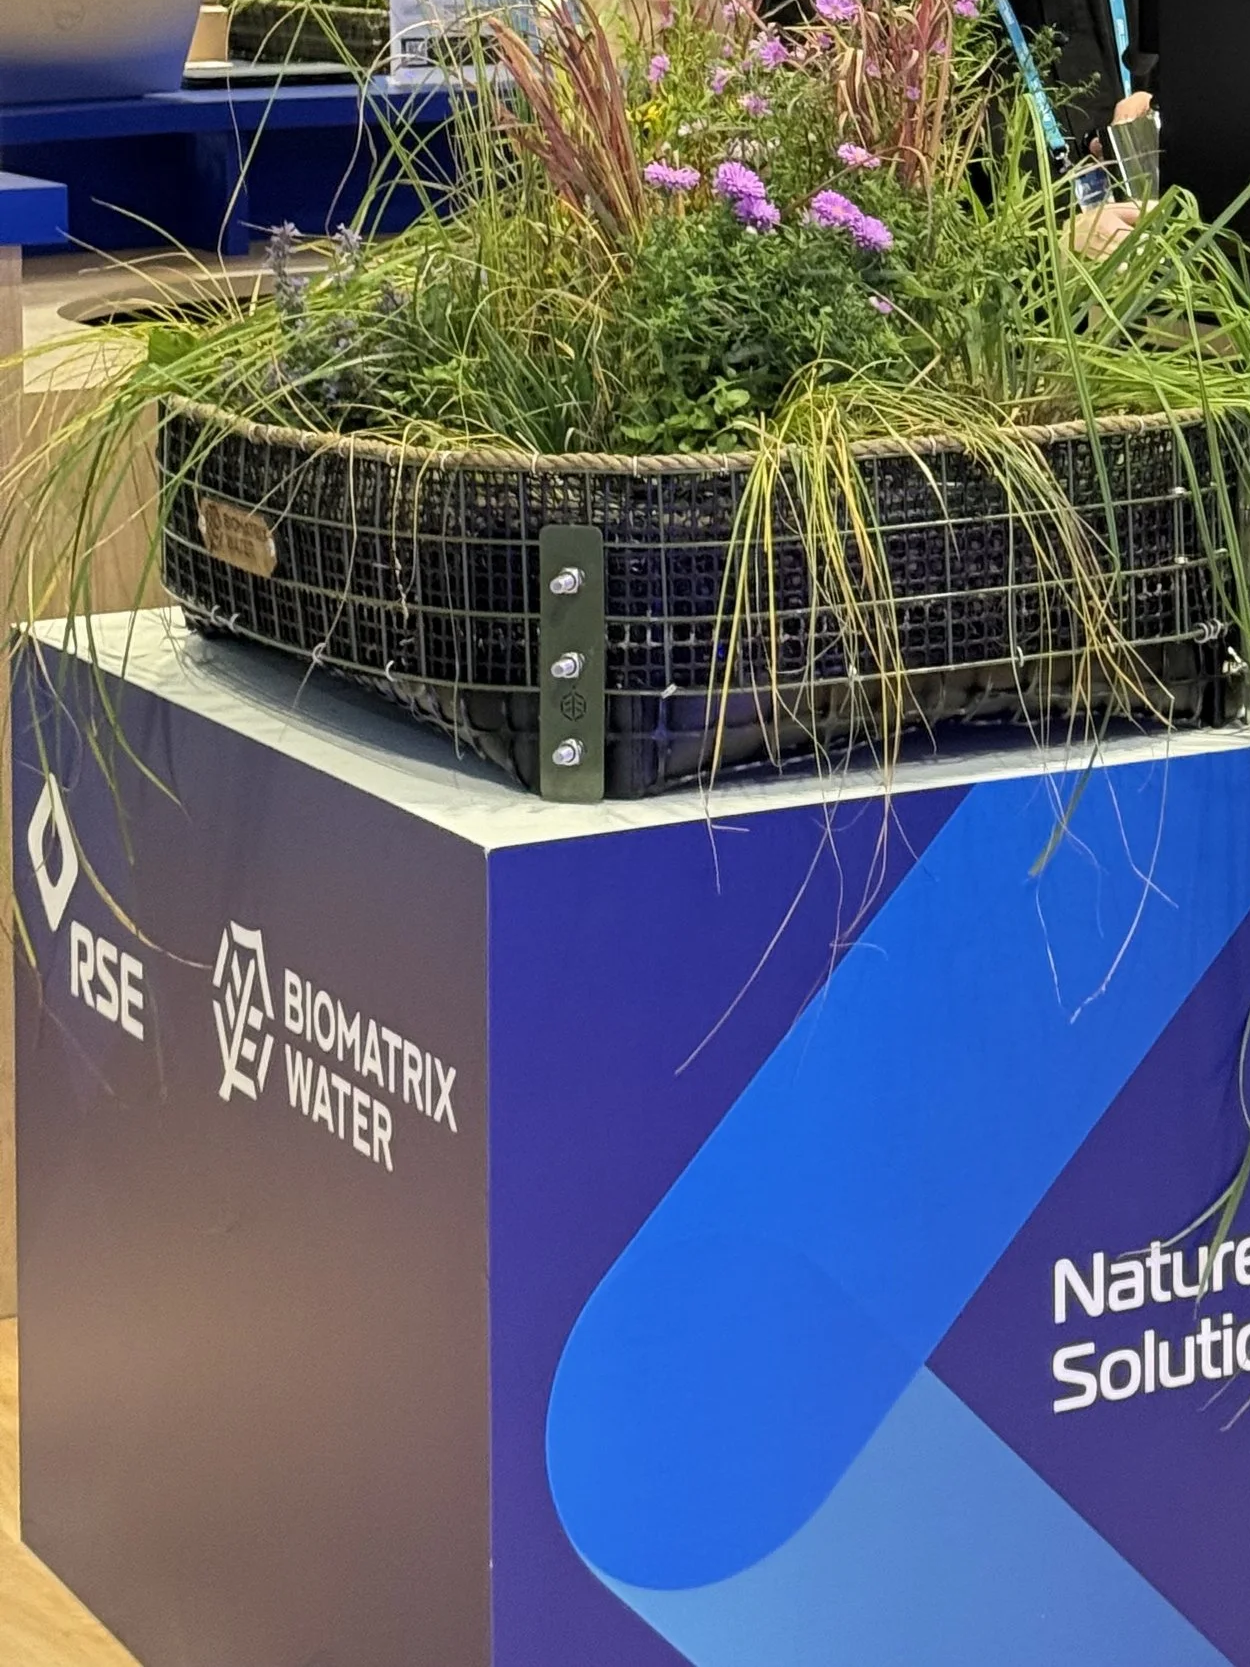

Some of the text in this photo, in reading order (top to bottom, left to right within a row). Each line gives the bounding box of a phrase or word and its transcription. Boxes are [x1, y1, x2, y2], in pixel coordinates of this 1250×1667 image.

[68, 920, 146, 1042] RSE
[284, 968, 459, 1133] BIOMATRIX
[284, 1043, 395, 1172] WATER
